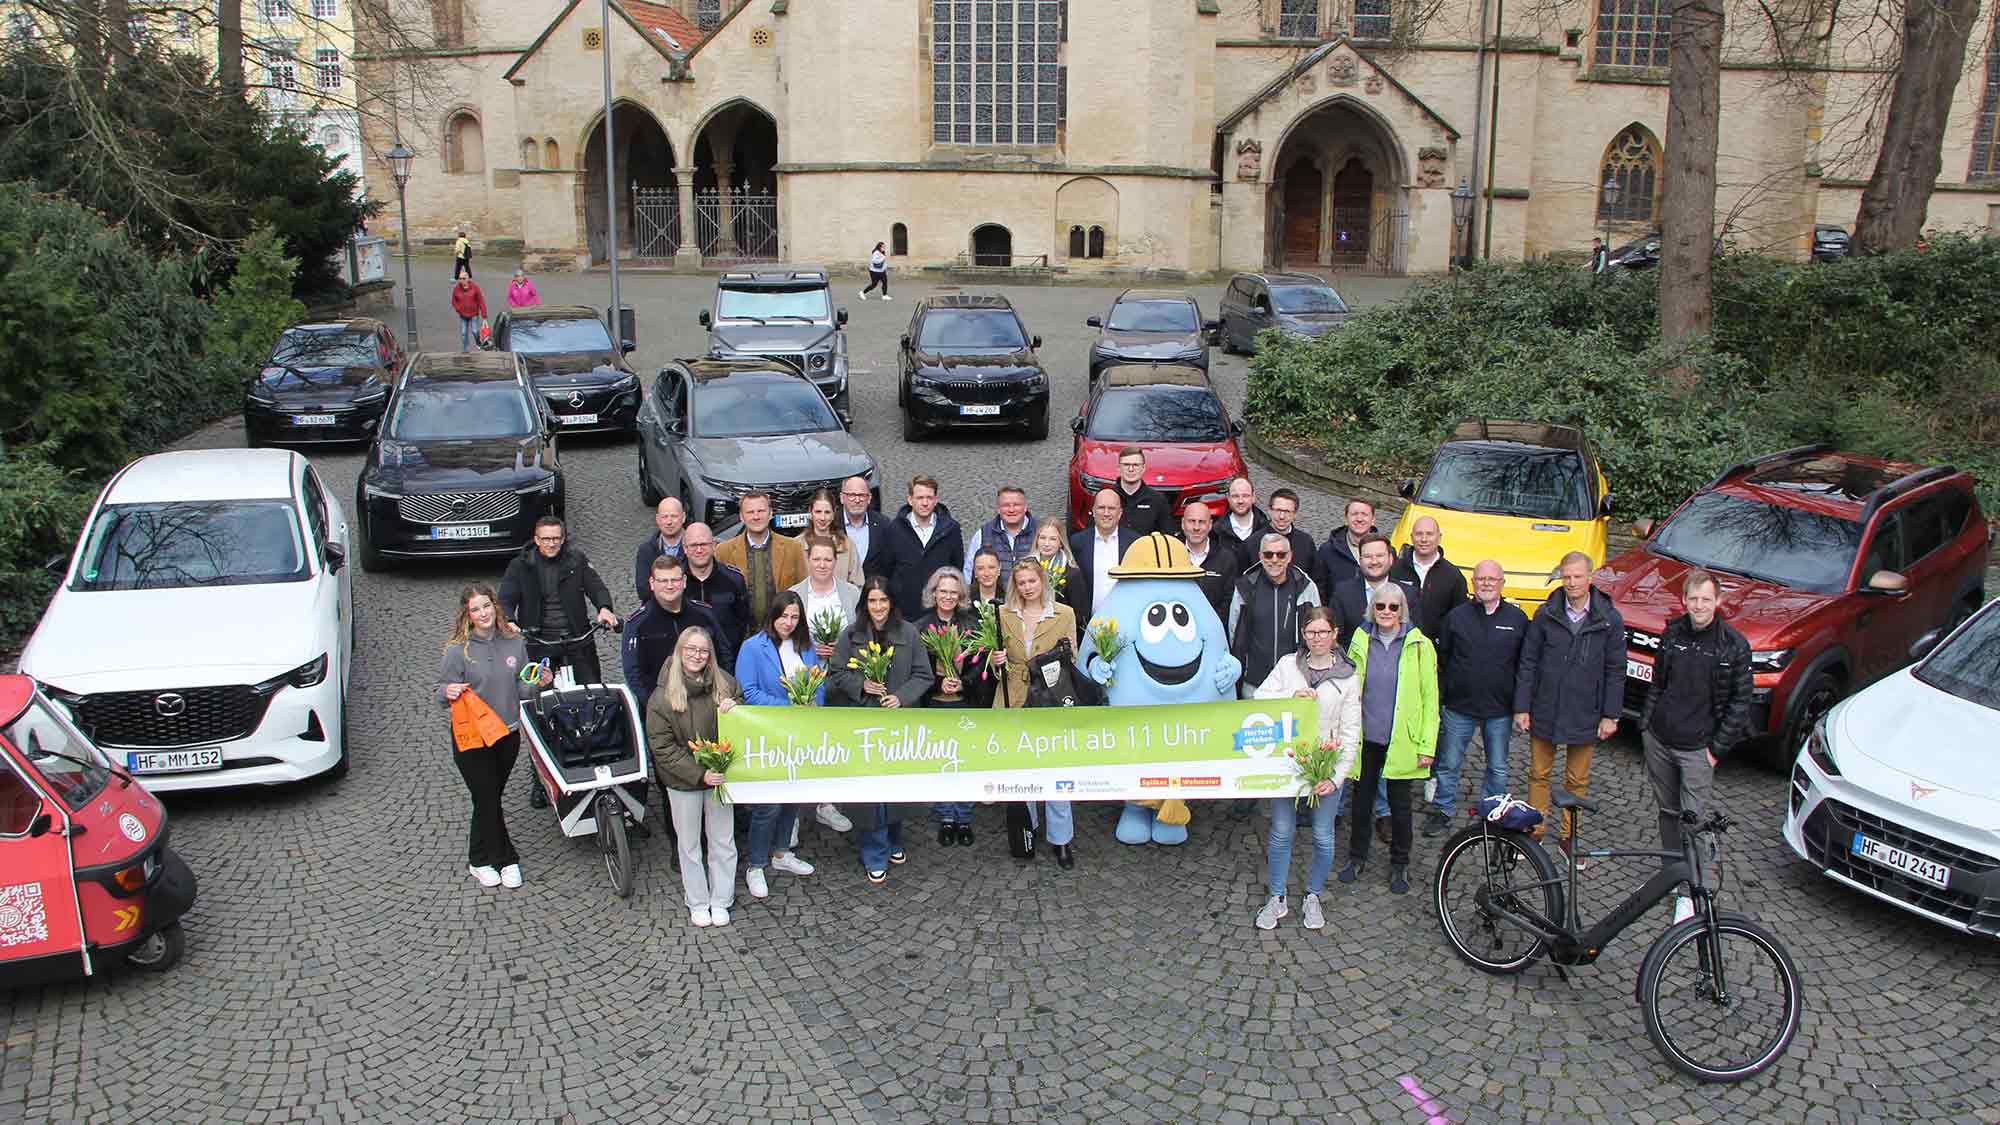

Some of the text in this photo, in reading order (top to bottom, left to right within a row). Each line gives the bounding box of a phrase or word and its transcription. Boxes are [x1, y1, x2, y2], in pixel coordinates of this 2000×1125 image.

[438, 528, 449, 537] HF
[138, 750, 219, 769] HF MM 152
[743, 720, 1212, 783] Herforder Frühling 6. April ab 11 Uhr
[1862, 838, 1947, 884] HF CU 2411
